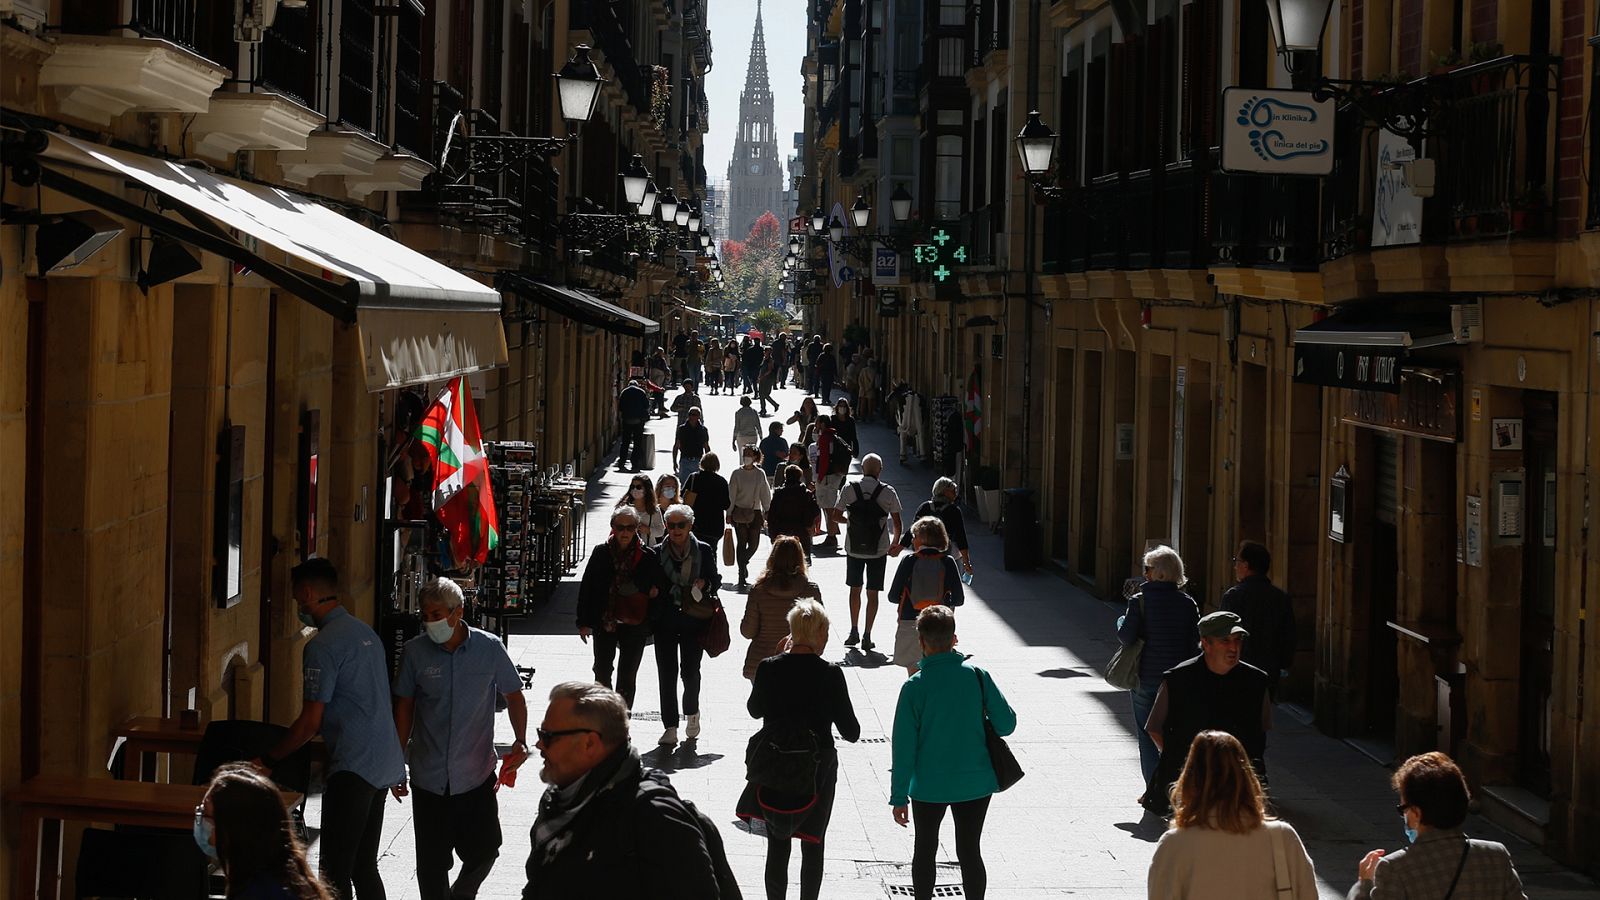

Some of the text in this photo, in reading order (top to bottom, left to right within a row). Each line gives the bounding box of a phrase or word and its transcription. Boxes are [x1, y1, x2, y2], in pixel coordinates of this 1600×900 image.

[1282, 114, 1308, 122] Klinika
[953, 246, 967, 263] 4
[877, 256, 896, 267] az
